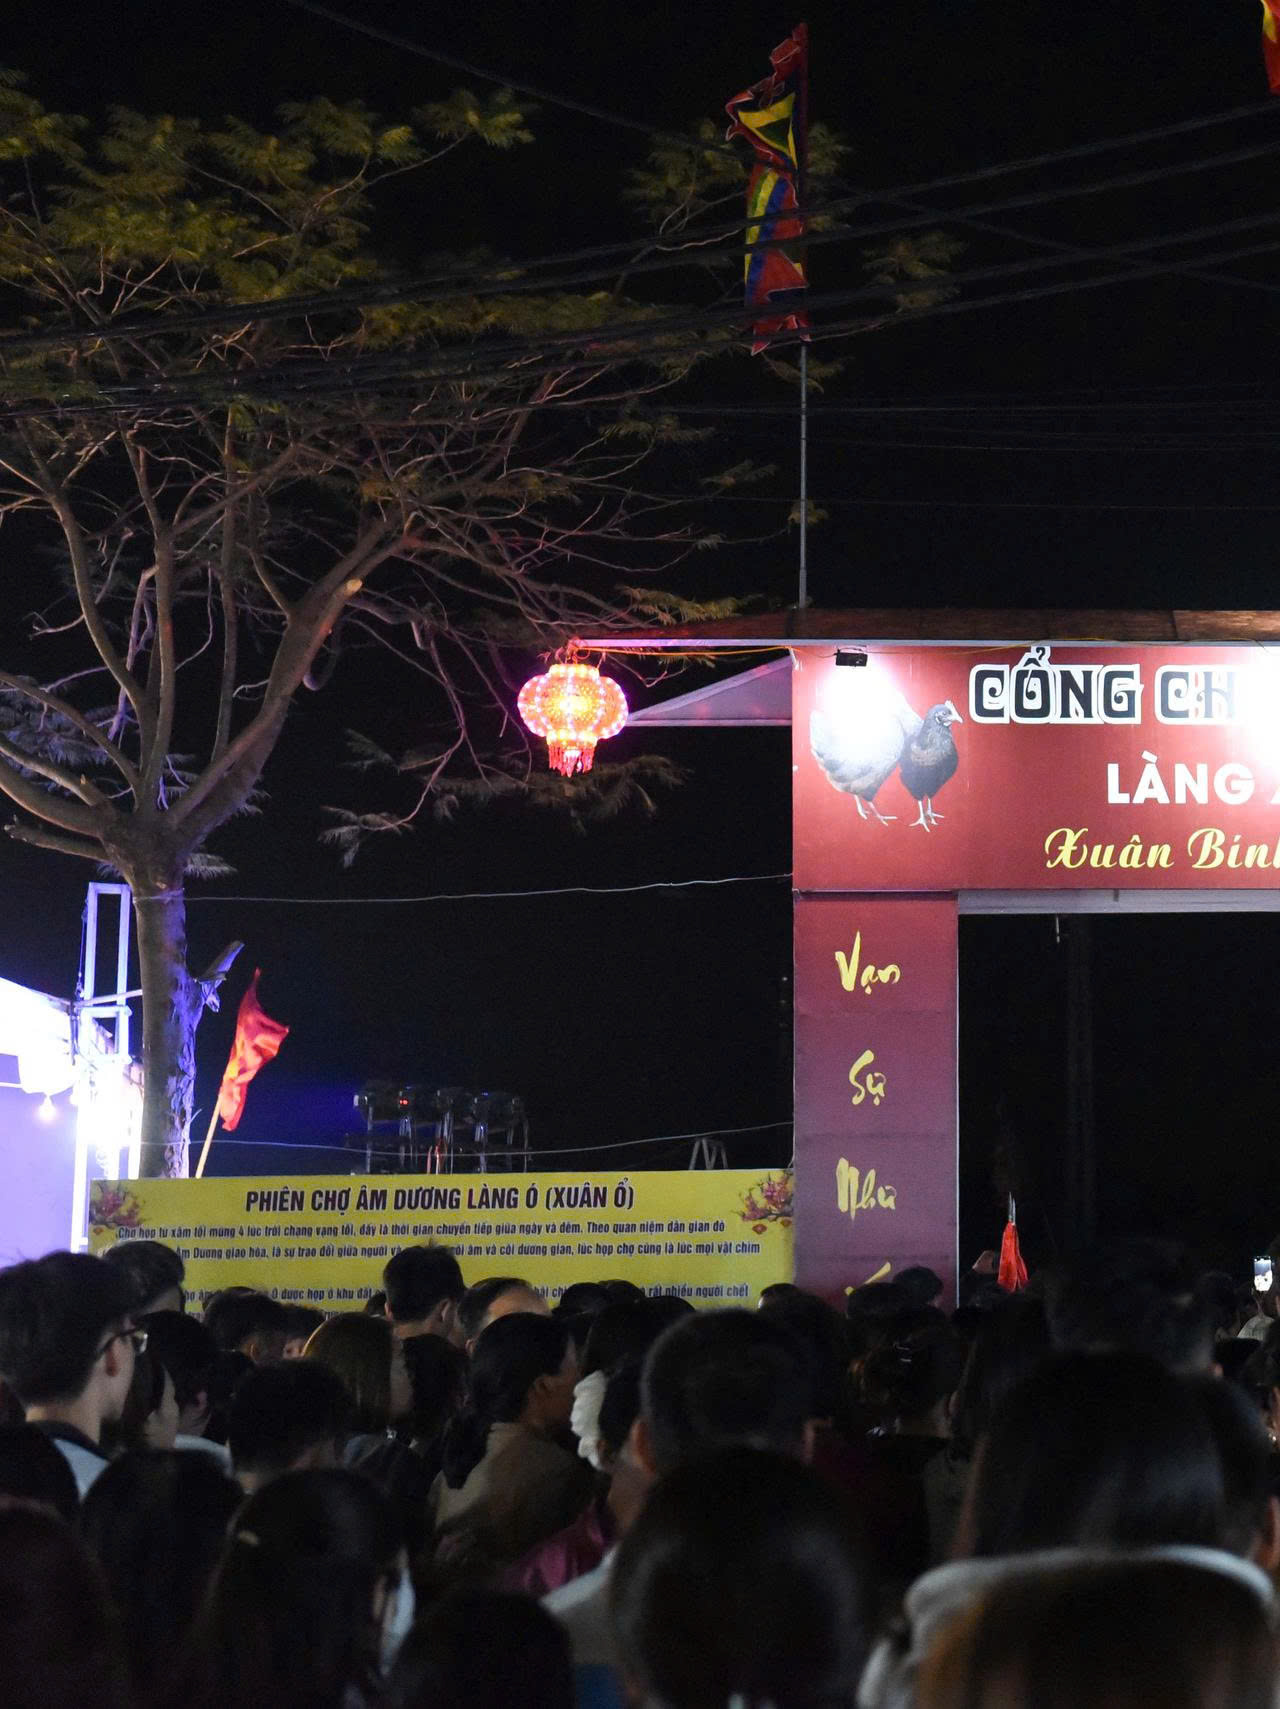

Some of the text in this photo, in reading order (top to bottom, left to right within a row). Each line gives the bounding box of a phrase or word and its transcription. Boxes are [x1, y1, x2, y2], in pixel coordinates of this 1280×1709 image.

[969, 646, 1143, 724] CỔNG
[1107, 751, 1255, 804] LÀNG
[1044, 828, 1173, 869] Xuân
[835, 930, 900, 994] Vạn
[849, 1049, 886, 1105] Sự
[246, 1177, 634, 1216] PHIÊN CHỢ ÂM DƯƠNG LÀNG Ó (XUÂN Ổ)
[836, 1157, 896, 1220] Như
[587, 1222, 609, 1234] Theo
[612, 1222, 636, 1234] quan
